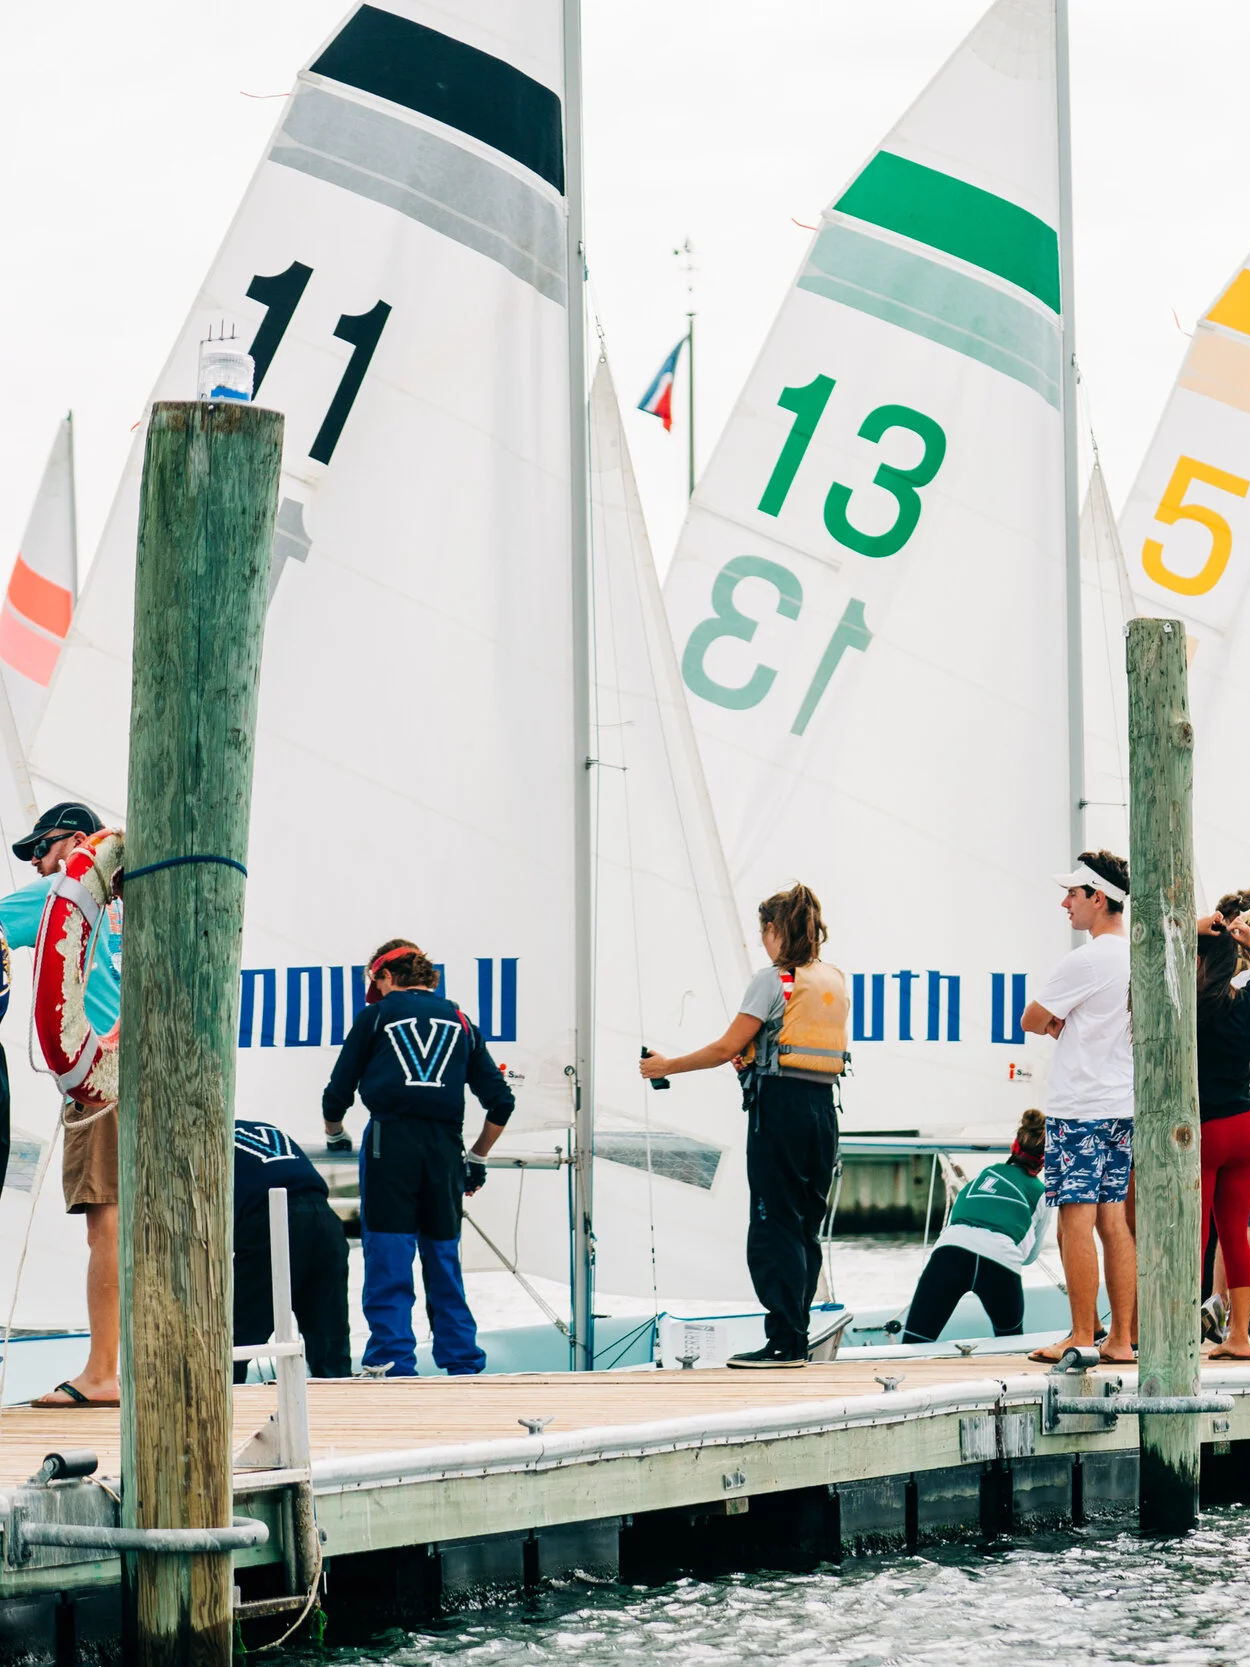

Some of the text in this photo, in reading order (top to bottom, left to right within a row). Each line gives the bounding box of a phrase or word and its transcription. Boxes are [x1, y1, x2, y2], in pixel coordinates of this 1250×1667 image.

[245, 260, 392, 466] 11
[757, 373, 946, 558] 13
[1141, 454, 1250, 597] 5
[384, 1017, 462, 1088] V
[978, 1175, 999, 1194] L
